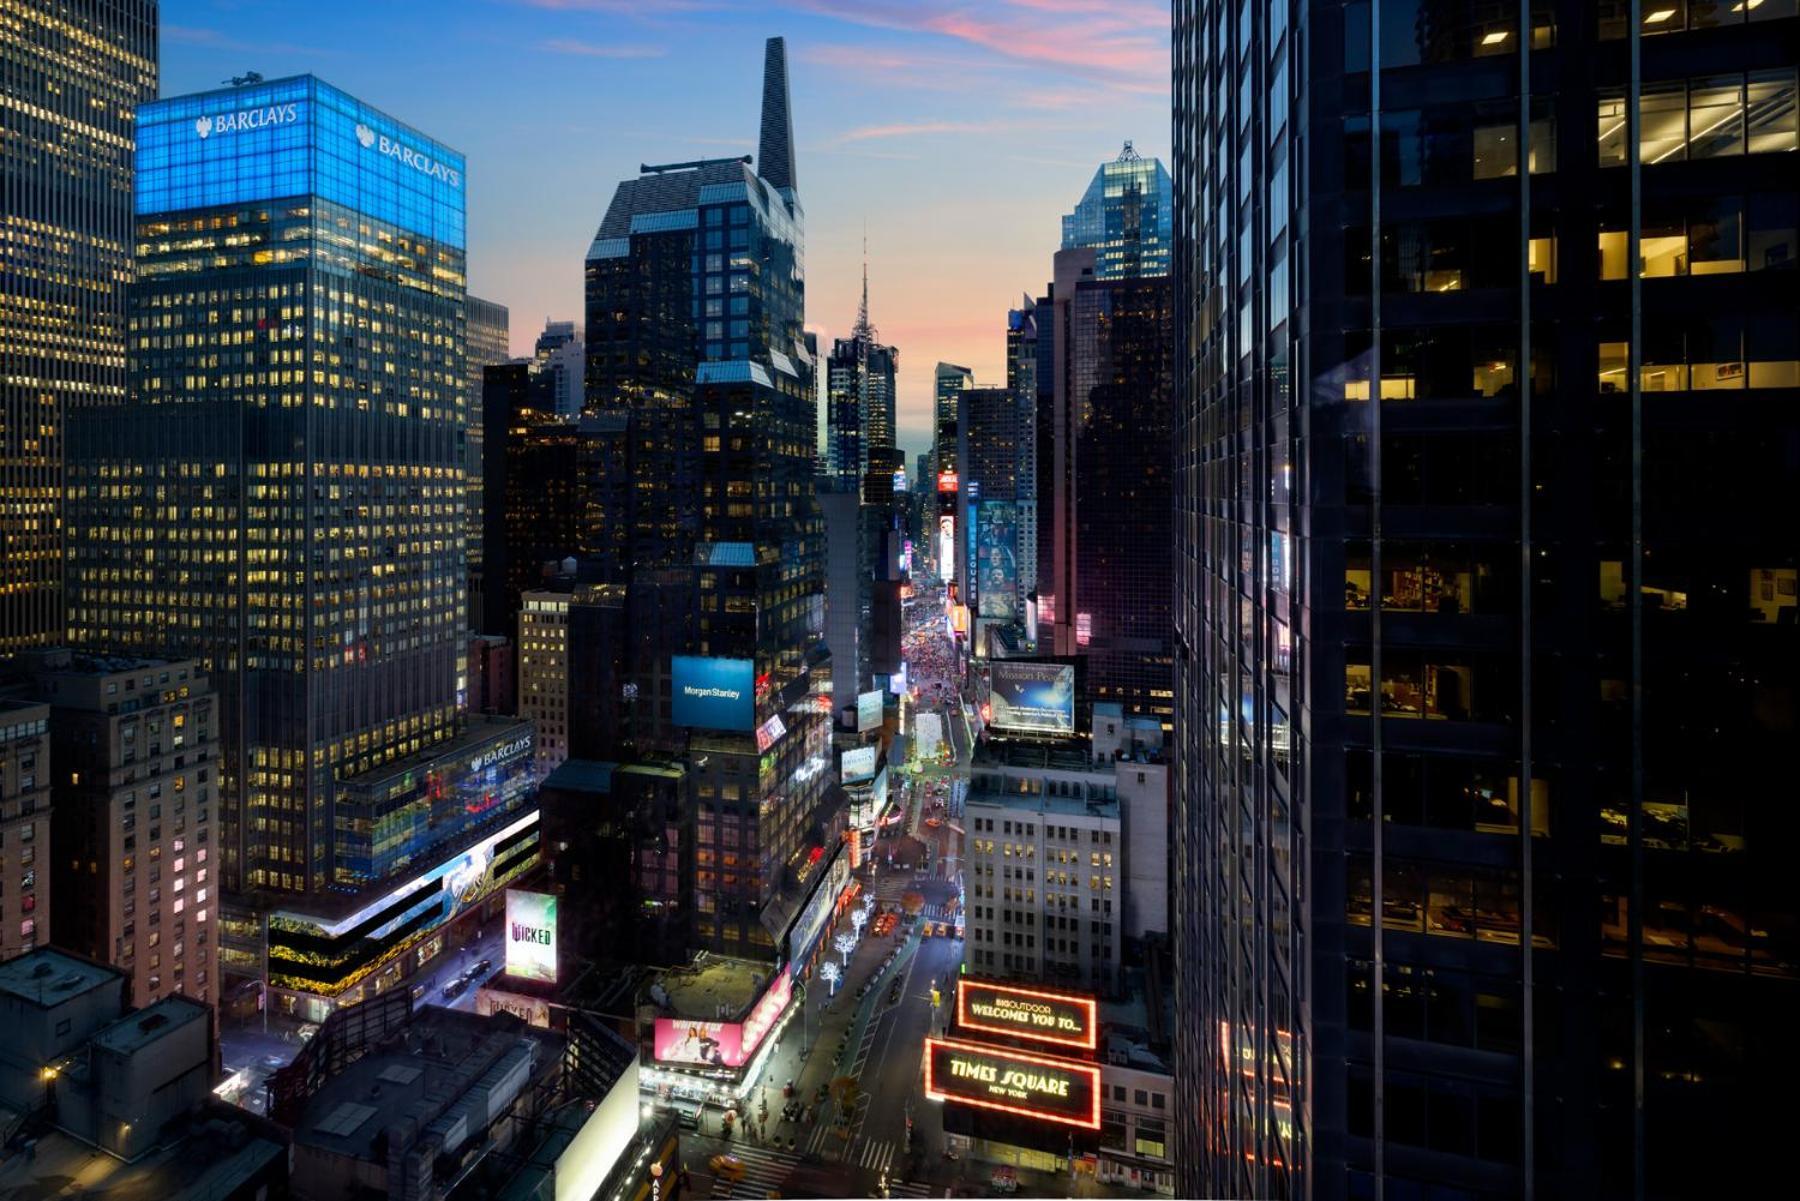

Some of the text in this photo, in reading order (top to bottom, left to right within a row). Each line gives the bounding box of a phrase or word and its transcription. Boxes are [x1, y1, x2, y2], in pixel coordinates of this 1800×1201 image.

[216, 104, 297, 133] BARCLAYS
[378, 136, 460, 187] BARCLAYS
[684, 686, 740, 700] Morgan Stanley
[484, 735, 531, 766] BARCLAYS
[511, 922, 552, 946] WICKED
[971, 1003, 1030, 1023] WELCOMES
[1032, 1013, 1056, 1026] YOU
[995, 998, 1051, 1014] BIGOUTDOOR
[950, 1060, 1069, 1096] TIMES SQUARE
[988, 1085, 1028, 1100] NEW YORK
